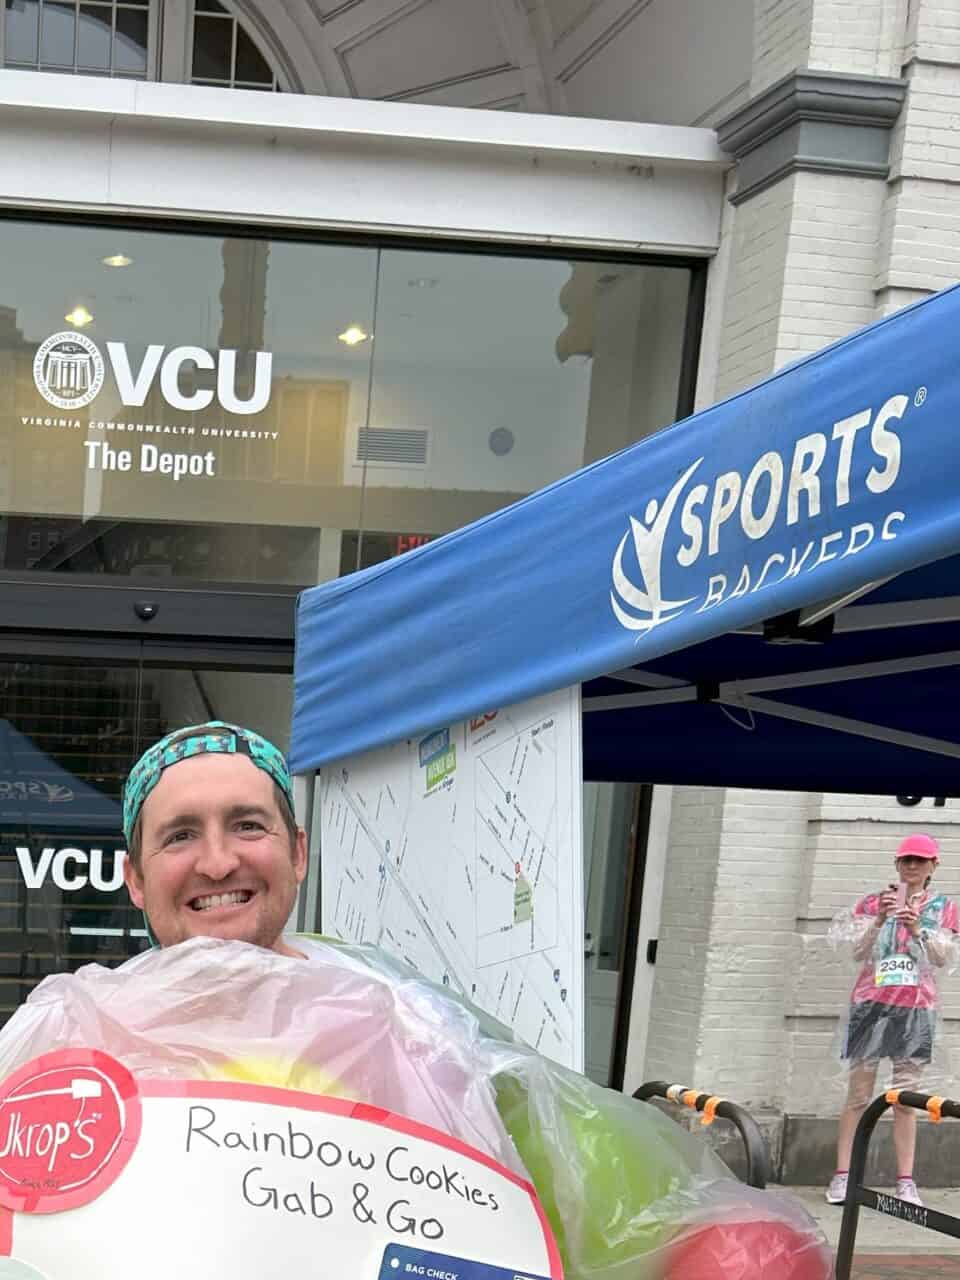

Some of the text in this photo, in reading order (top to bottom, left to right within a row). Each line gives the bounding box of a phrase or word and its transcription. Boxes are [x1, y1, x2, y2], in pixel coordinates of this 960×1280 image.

[106, 341, 273, 415] VCU
[21, 417, 280, 441] VIRGINIA COMMONWEALTH UNIVERSITY
[83, 440, 216, 481] The Depot
[676, 394, 909, 567] SPORTS
[15, 847, 128, 892] VCU
[880, 959, 915, 972] 2340
[186, 1105, 376, 1171] Rainbow
[242, 1166, 445, 1240] Gab & Go
[405, 1263, 426, 1276] BAG
